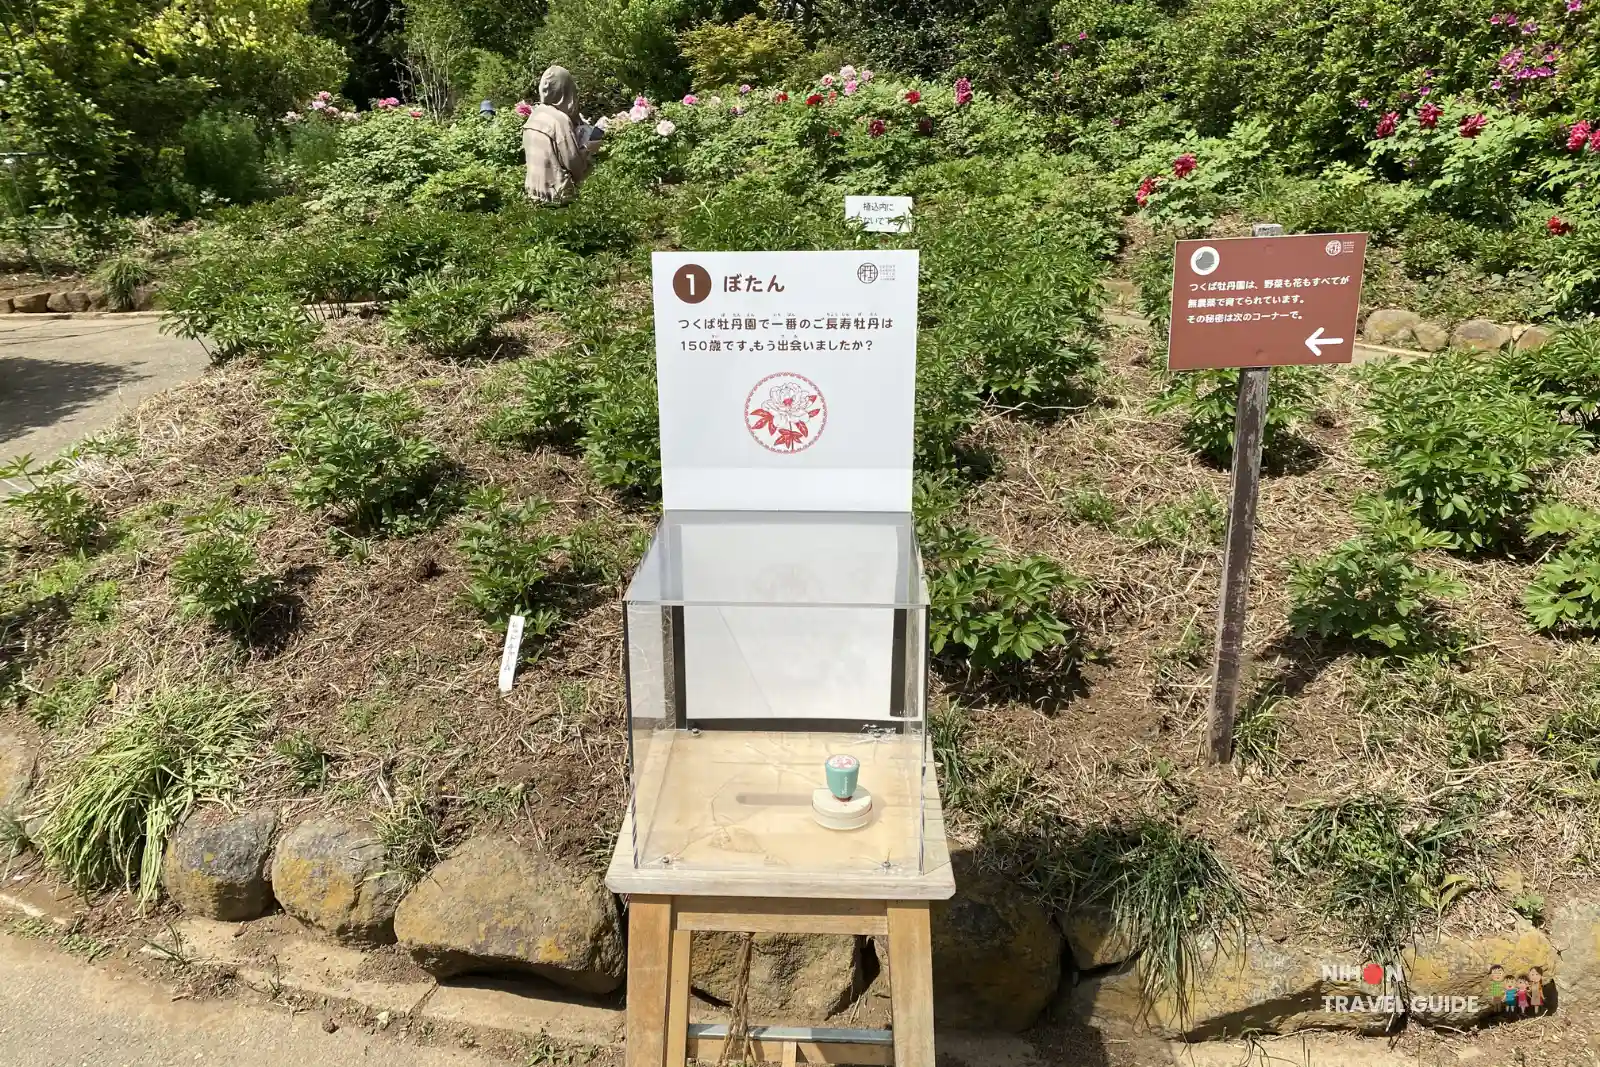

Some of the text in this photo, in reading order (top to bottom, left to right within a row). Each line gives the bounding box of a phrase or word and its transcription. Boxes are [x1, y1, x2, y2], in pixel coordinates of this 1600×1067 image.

[685, 274, 696, 296] 1
[723, 274, 785, 293] ぼたん
[677, 317, 893, 331] つくば牡丹園で一番のご長寿牡丹は
[1186, 311, 1303, 324] その秘密は次のコーナーで。
